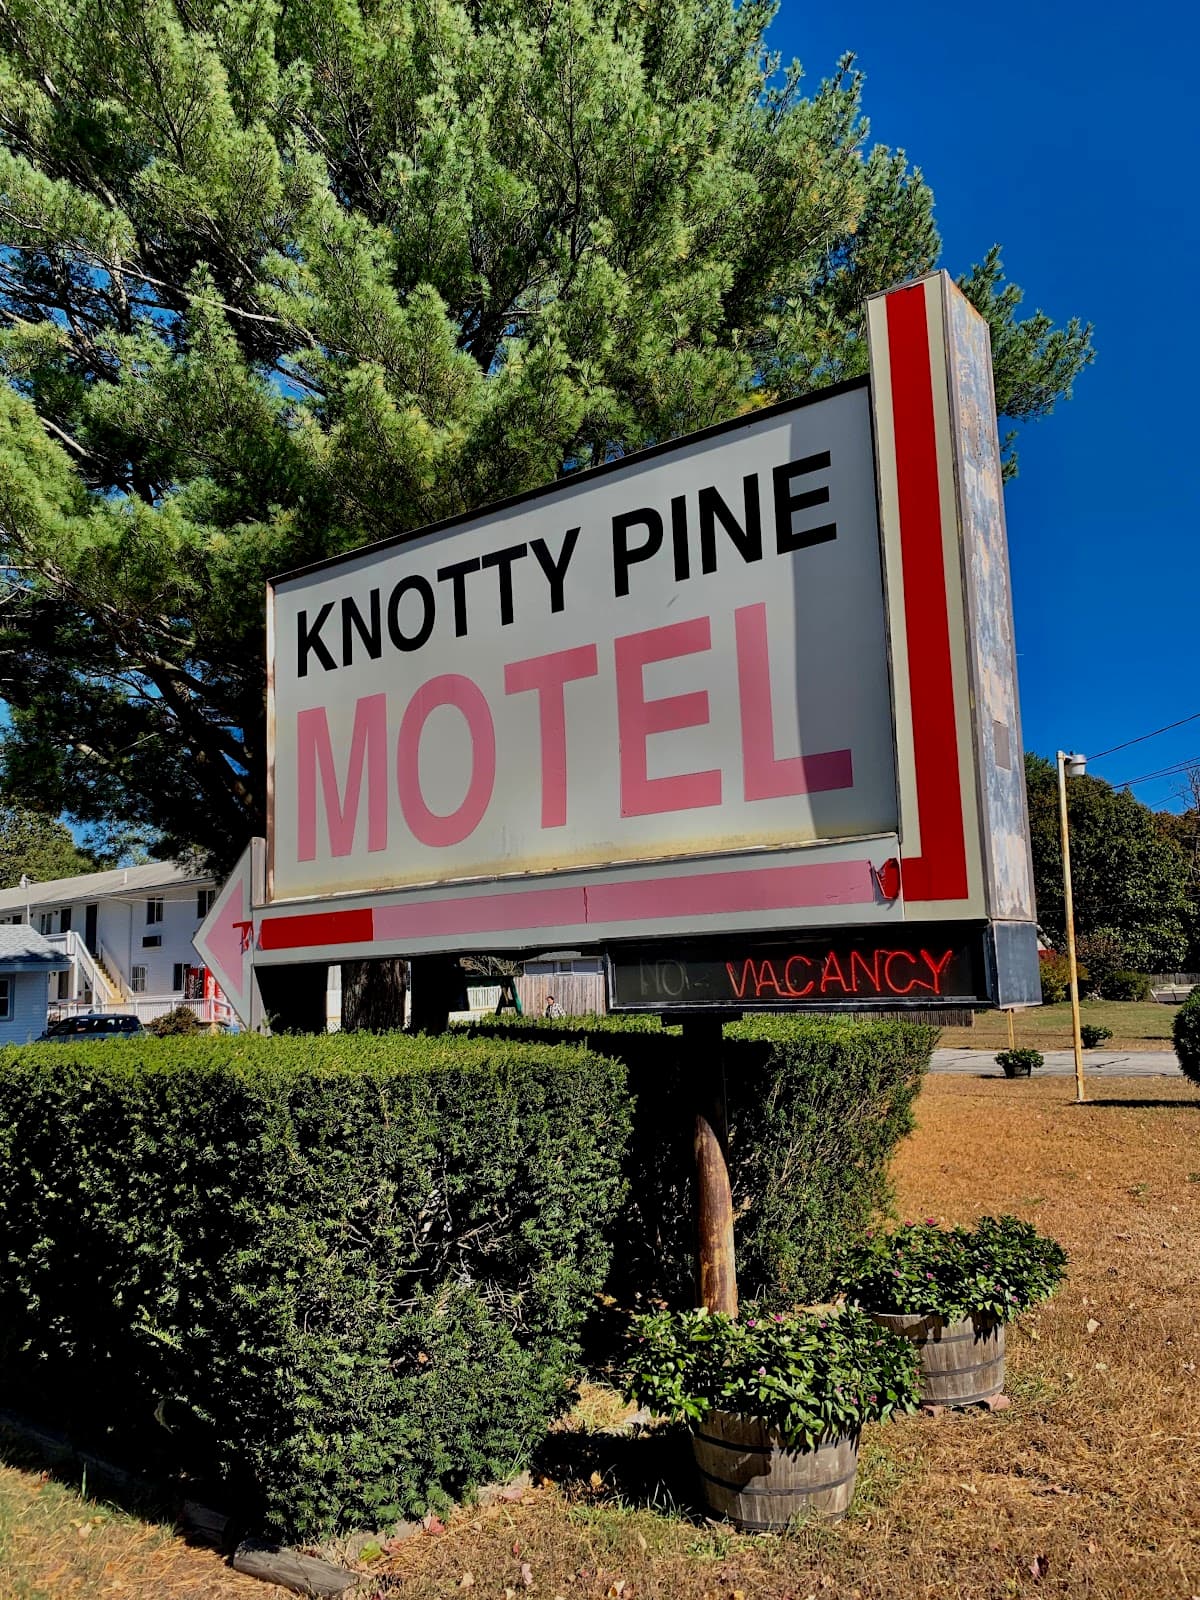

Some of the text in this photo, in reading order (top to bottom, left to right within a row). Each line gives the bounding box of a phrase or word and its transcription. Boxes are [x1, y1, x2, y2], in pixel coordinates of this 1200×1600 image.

[297, 450, 837, 677] KNOTTY PINE
[297, 602, 853, 862] MOTEL
[640, 949, 953, 997] NO VACANCY
